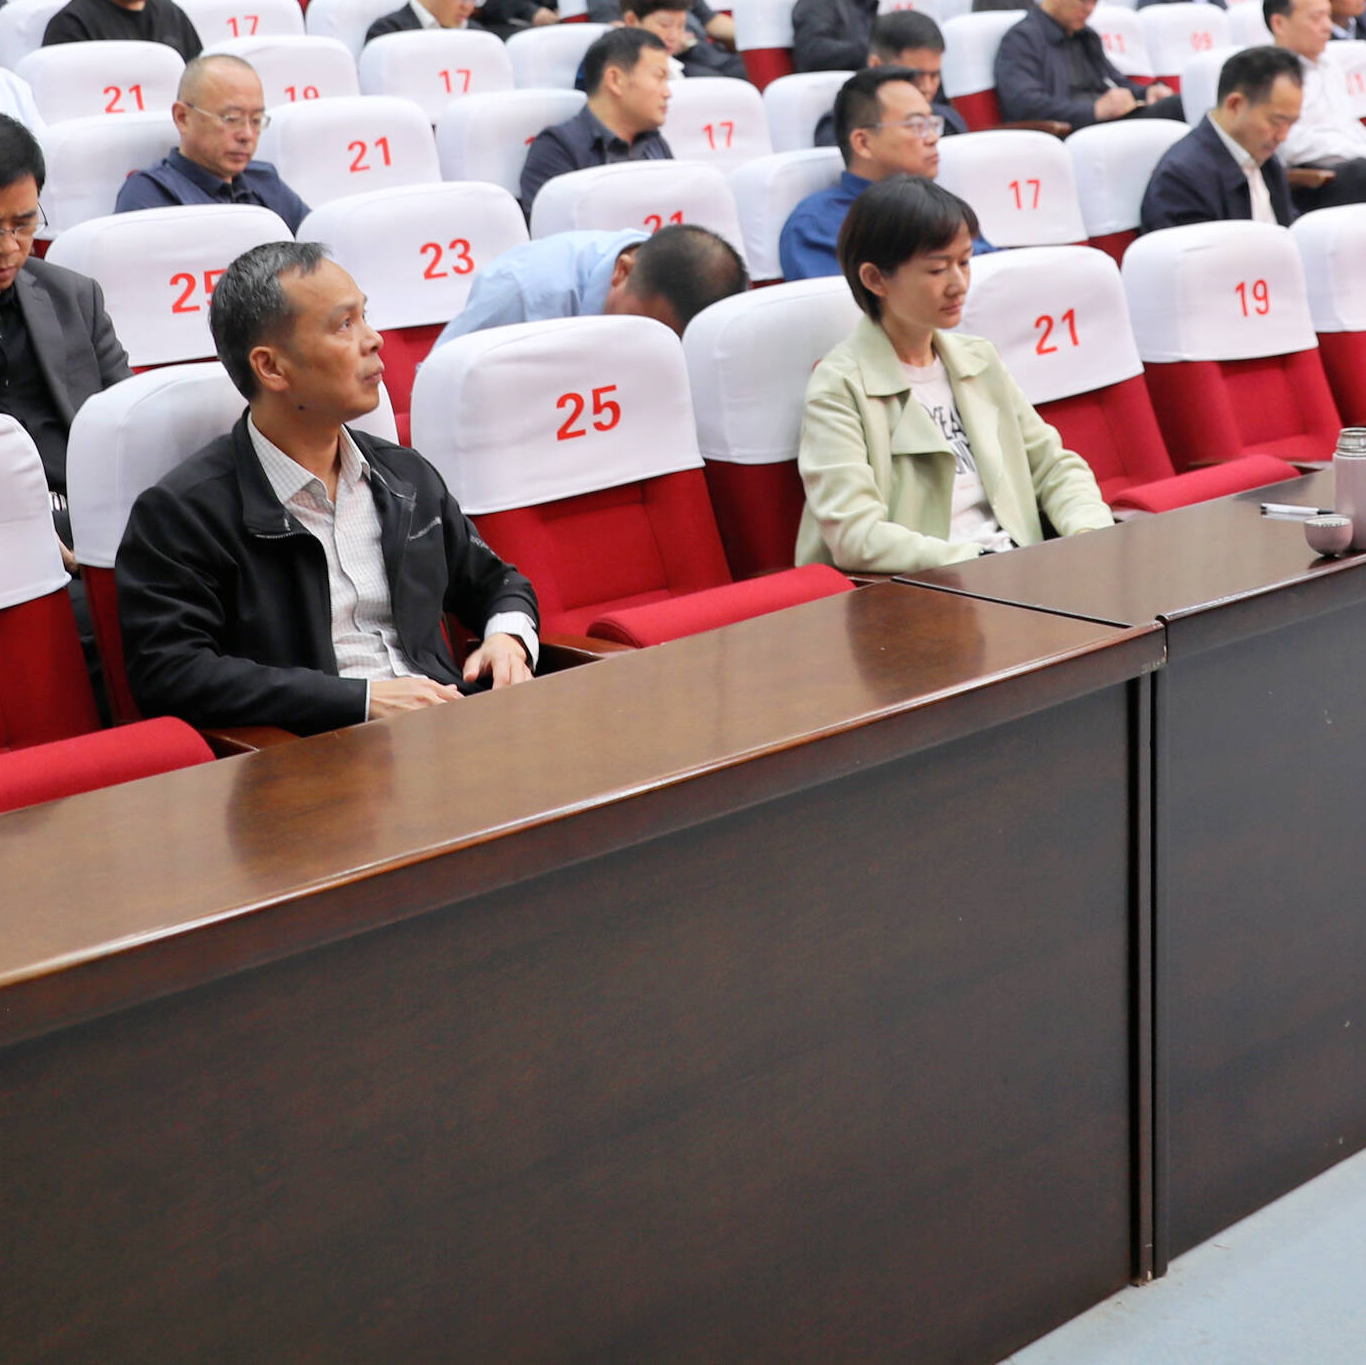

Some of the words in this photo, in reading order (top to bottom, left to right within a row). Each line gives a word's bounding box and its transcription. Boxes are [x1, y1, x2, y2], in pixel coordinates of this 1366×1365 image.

[227, 14, 259, 38] 17
[102, 83, 144, 114] 21
[438, 68, 472, 94] 17
[702, 120, 735, 150] 17
[347, 136, 392, 174] 21
[1008, 177, 1042, 211] 17
[420, 238, 475, 281] 23
[1234, 278, 1271, 318] 19
[1032, 307, 1080, 357] 21
[555, 384, 622, 442] 25
